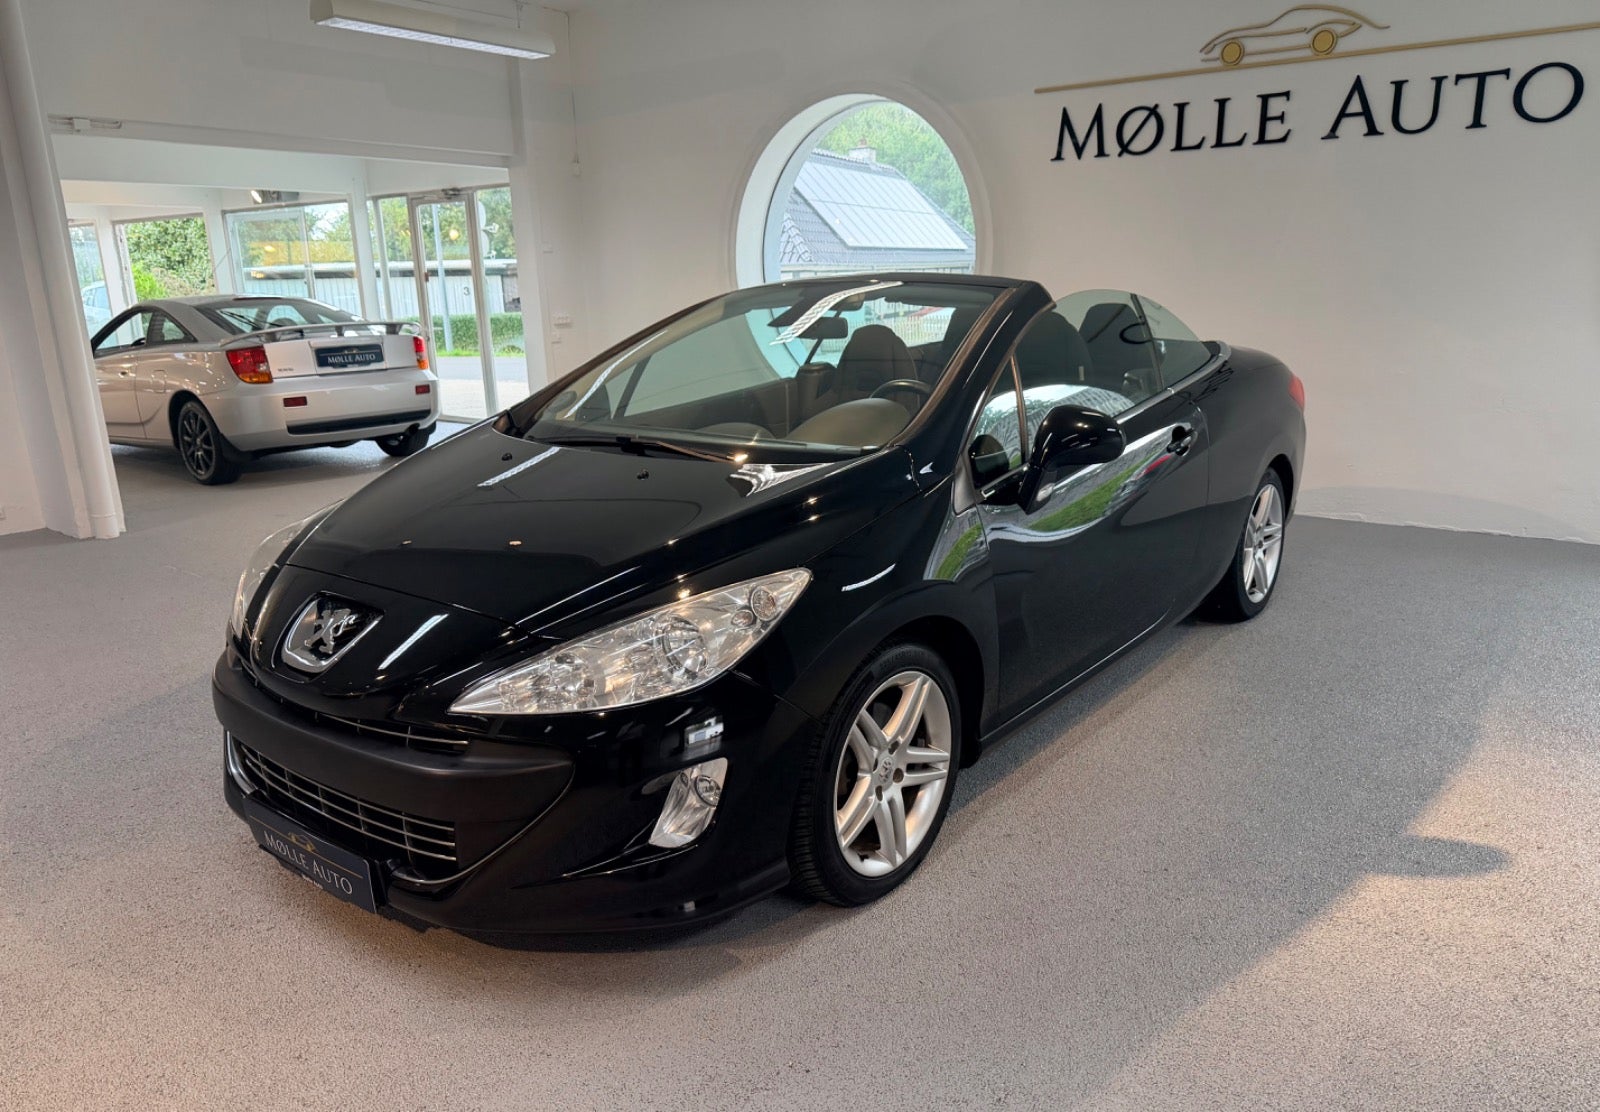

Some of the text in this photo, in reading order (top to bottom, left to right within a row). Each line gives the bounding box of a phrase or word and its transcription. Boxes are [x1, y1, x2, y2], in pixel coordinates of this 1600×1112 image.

[1050, 62, 1585, 162] MØLLE AUTO
[463, 286, 471, 296] 3
[354, 353, 376, 362] AUTO
[263, 830, 309, 870] MØLLE
[313, 859, 353, 895] AUTO
